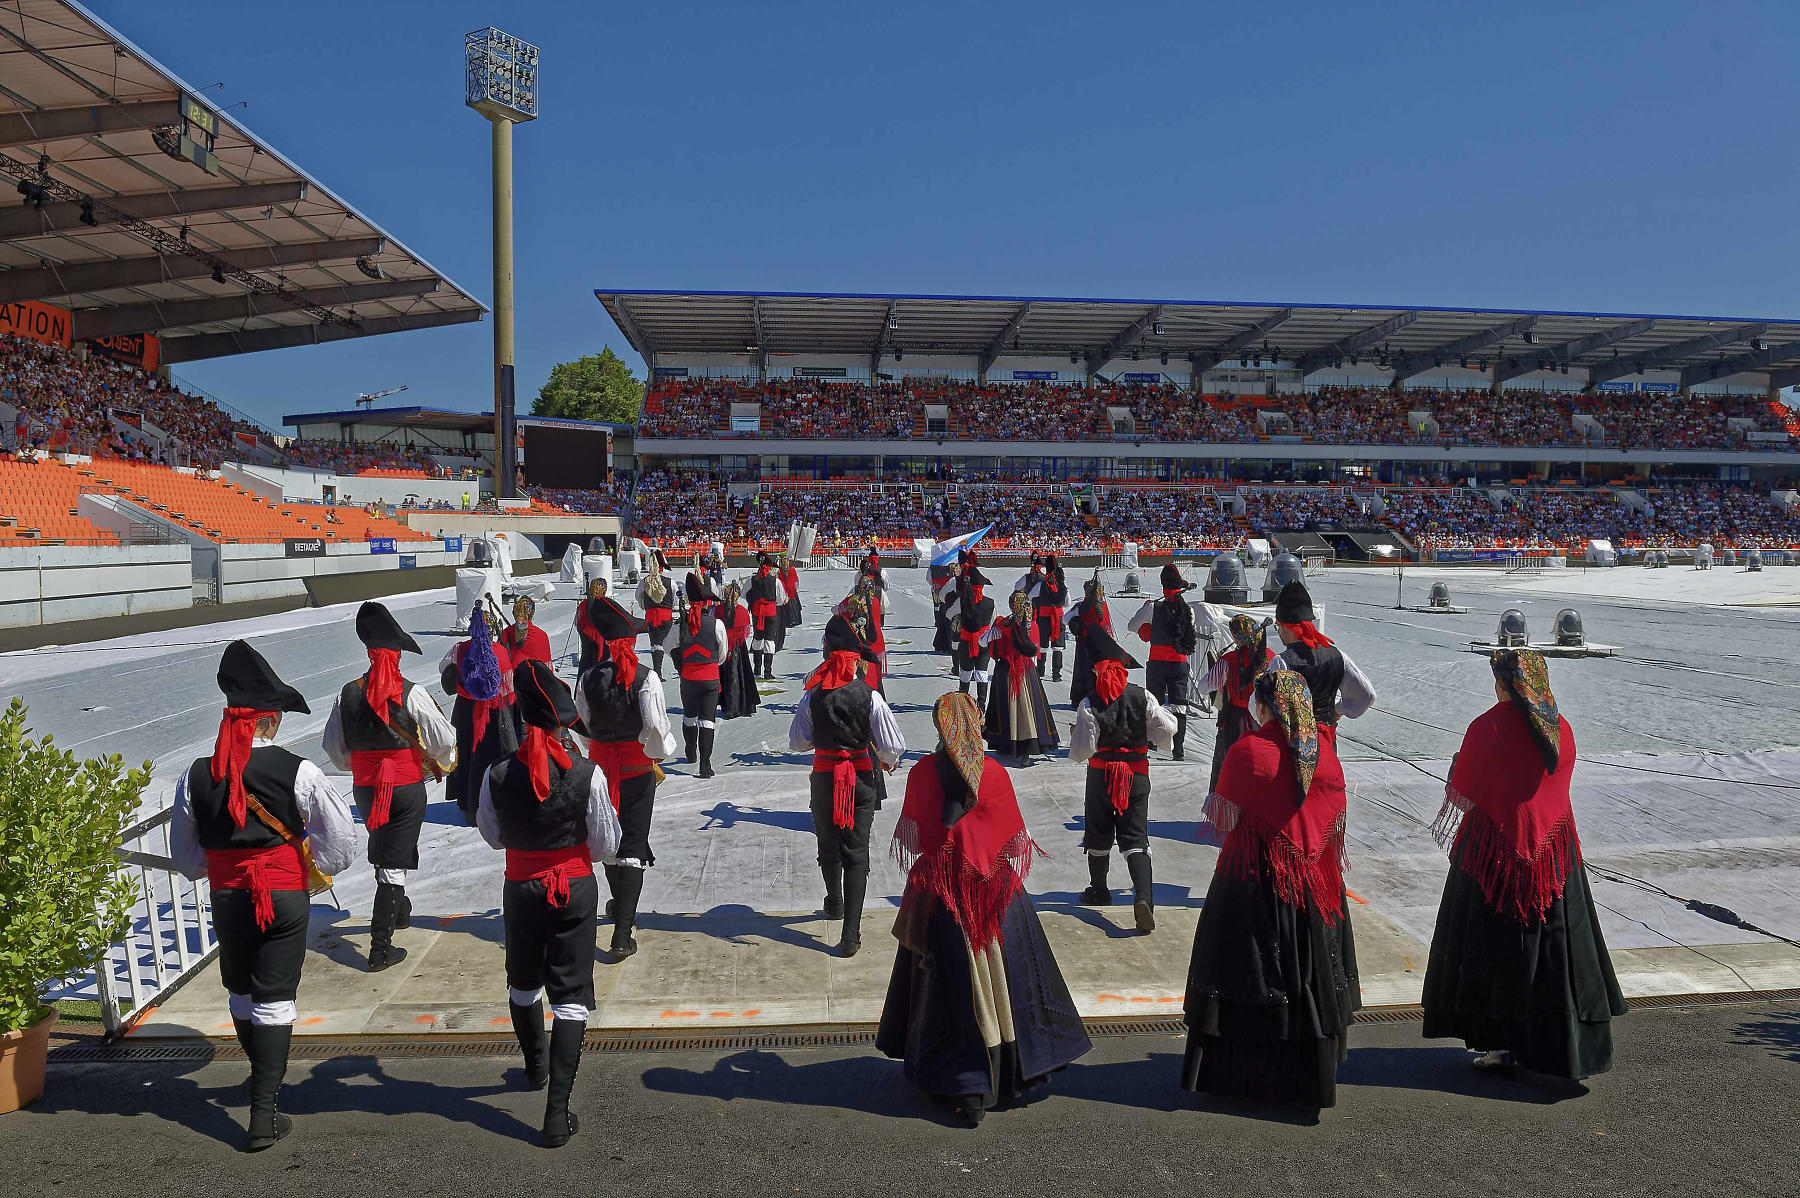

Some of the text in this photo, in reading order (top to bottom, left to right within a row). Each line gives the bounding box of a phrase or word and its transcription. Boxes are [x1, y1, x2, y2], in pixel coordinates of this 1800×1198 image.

[189, 104, 213, 131] 12:31
[0, 303, 65, 341] ATION
[294, 542, 319, 552] BRETAGNE
